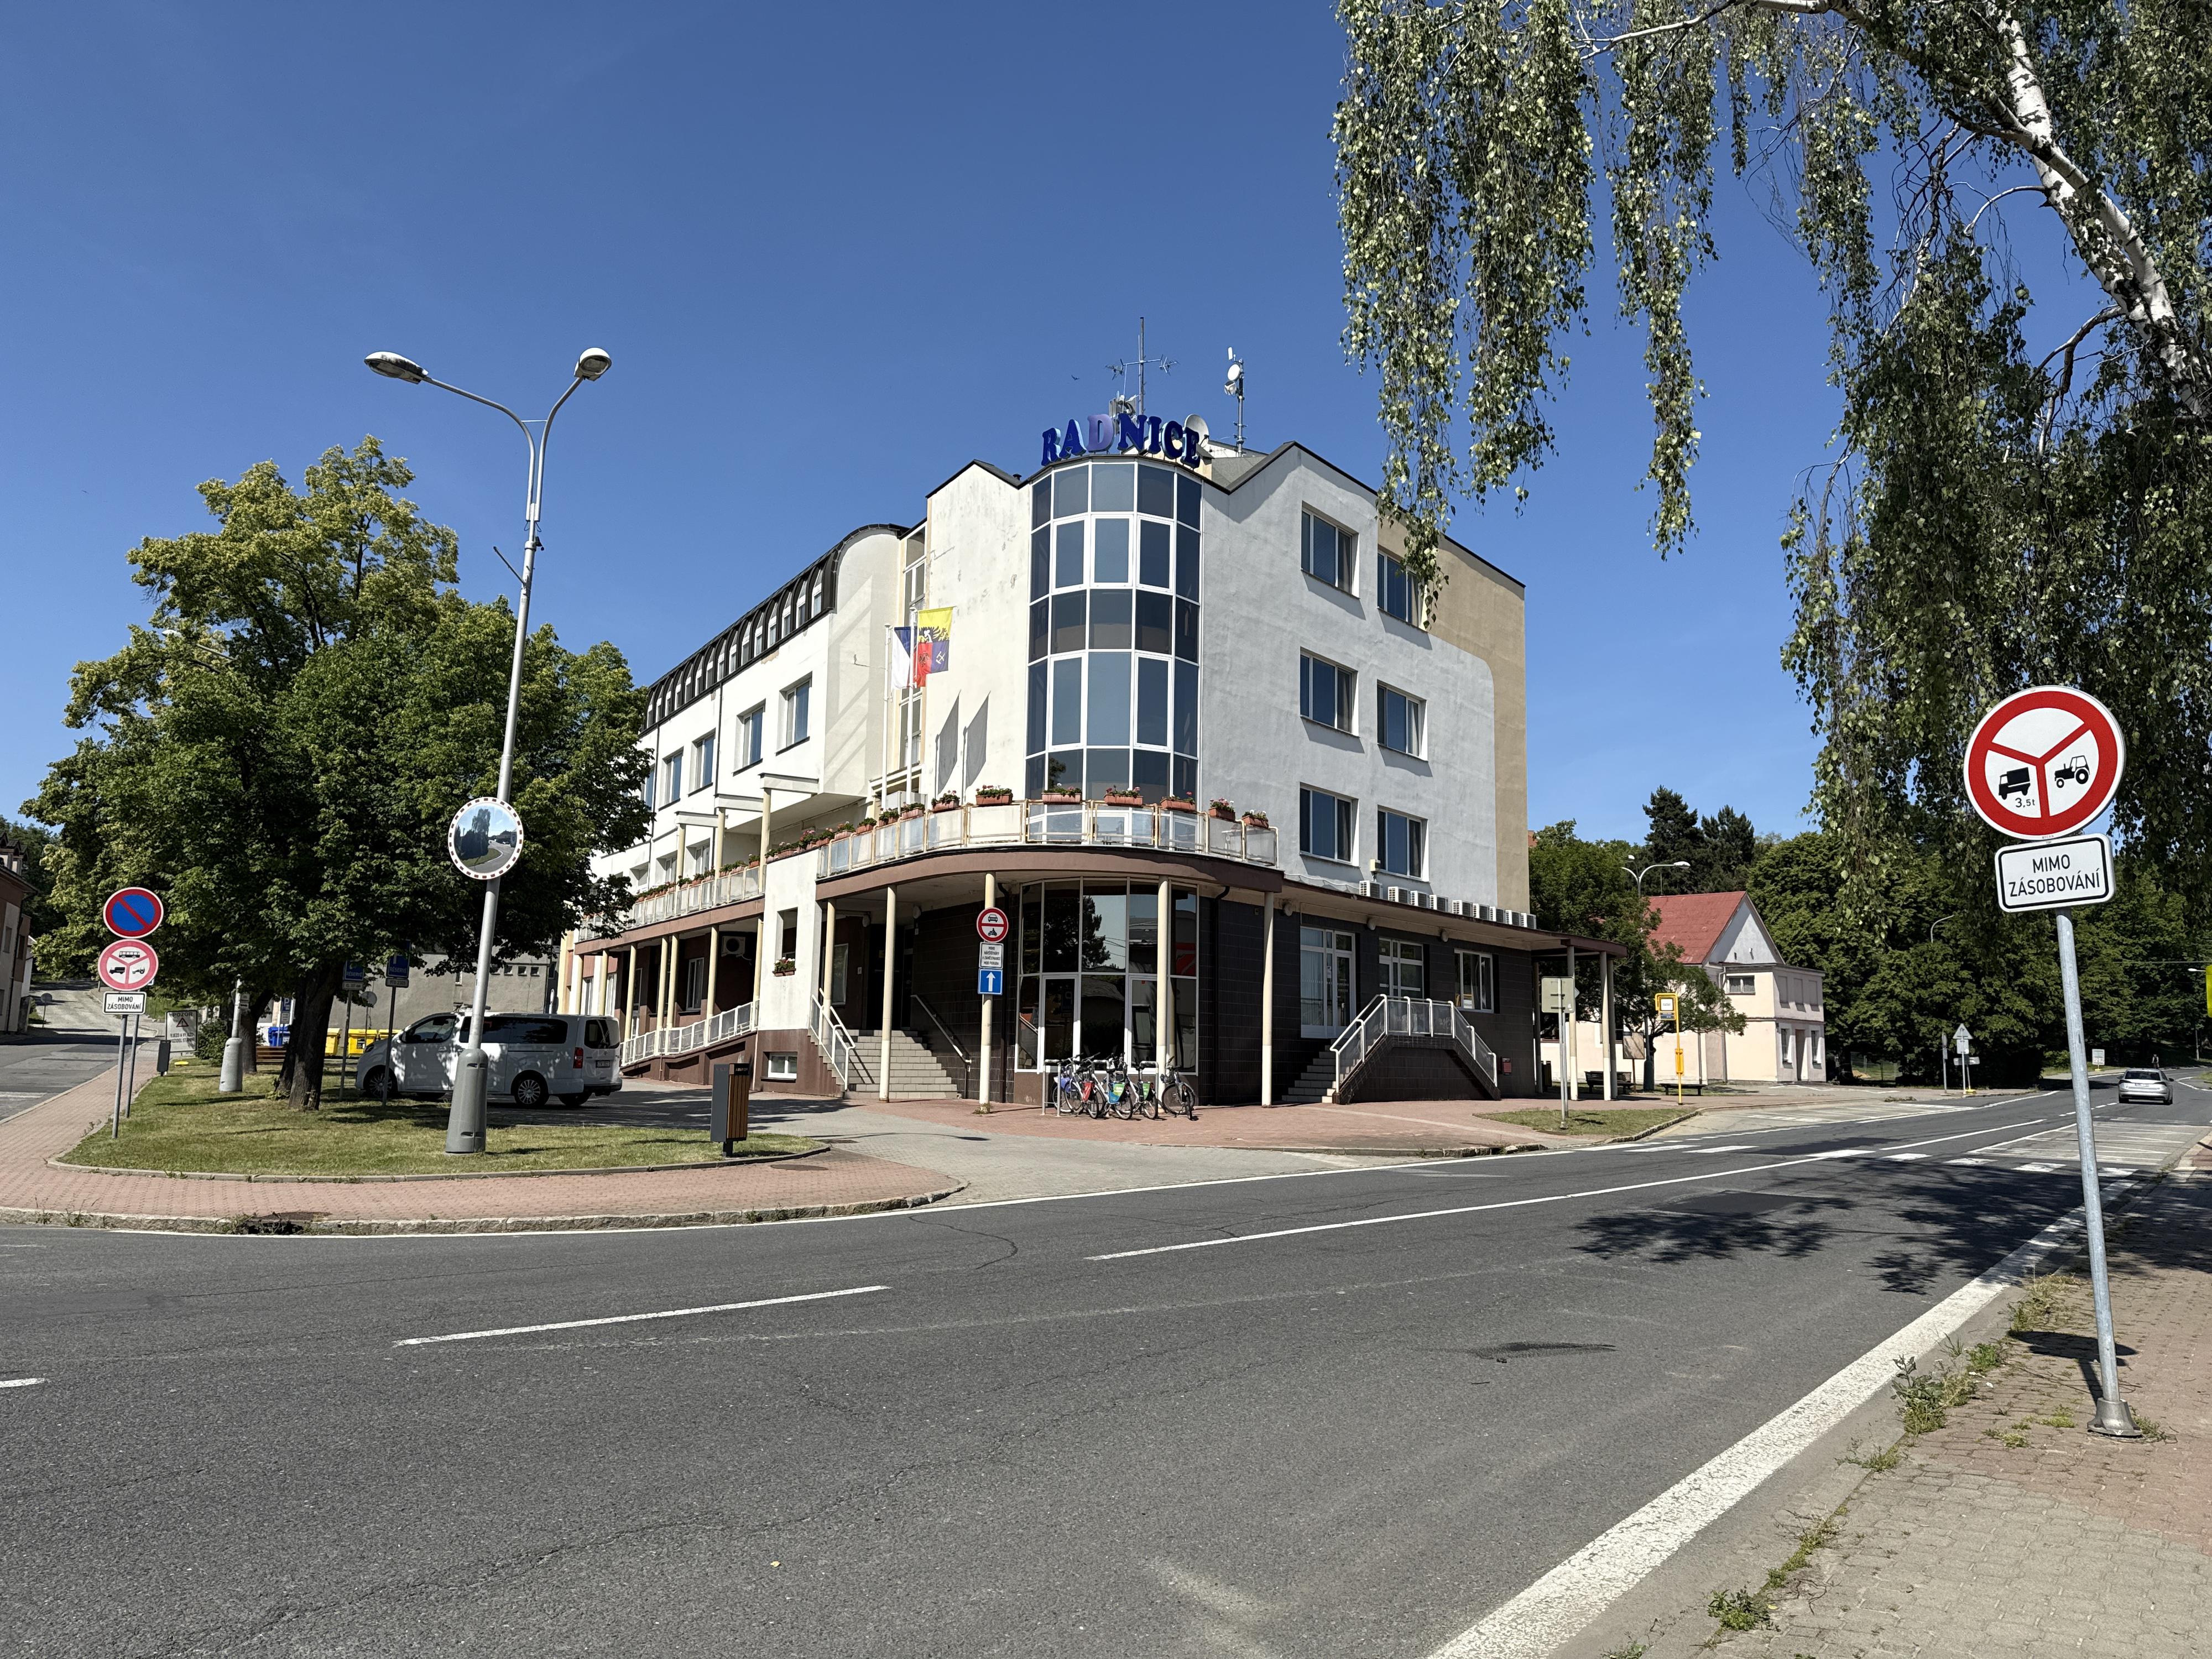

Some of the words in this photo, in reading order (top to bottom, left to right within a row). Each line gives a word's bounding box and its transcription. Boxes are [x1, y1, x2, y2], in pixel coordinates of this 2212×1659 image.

[1041, 413, 1201, 468] RADNICE
[2015, 797, 2036, 808] 3,5t
[2032, 854, 2070, 874] MIMO
[2008, 868, 2100, 897] ZÁSOBOVÁNÍ
